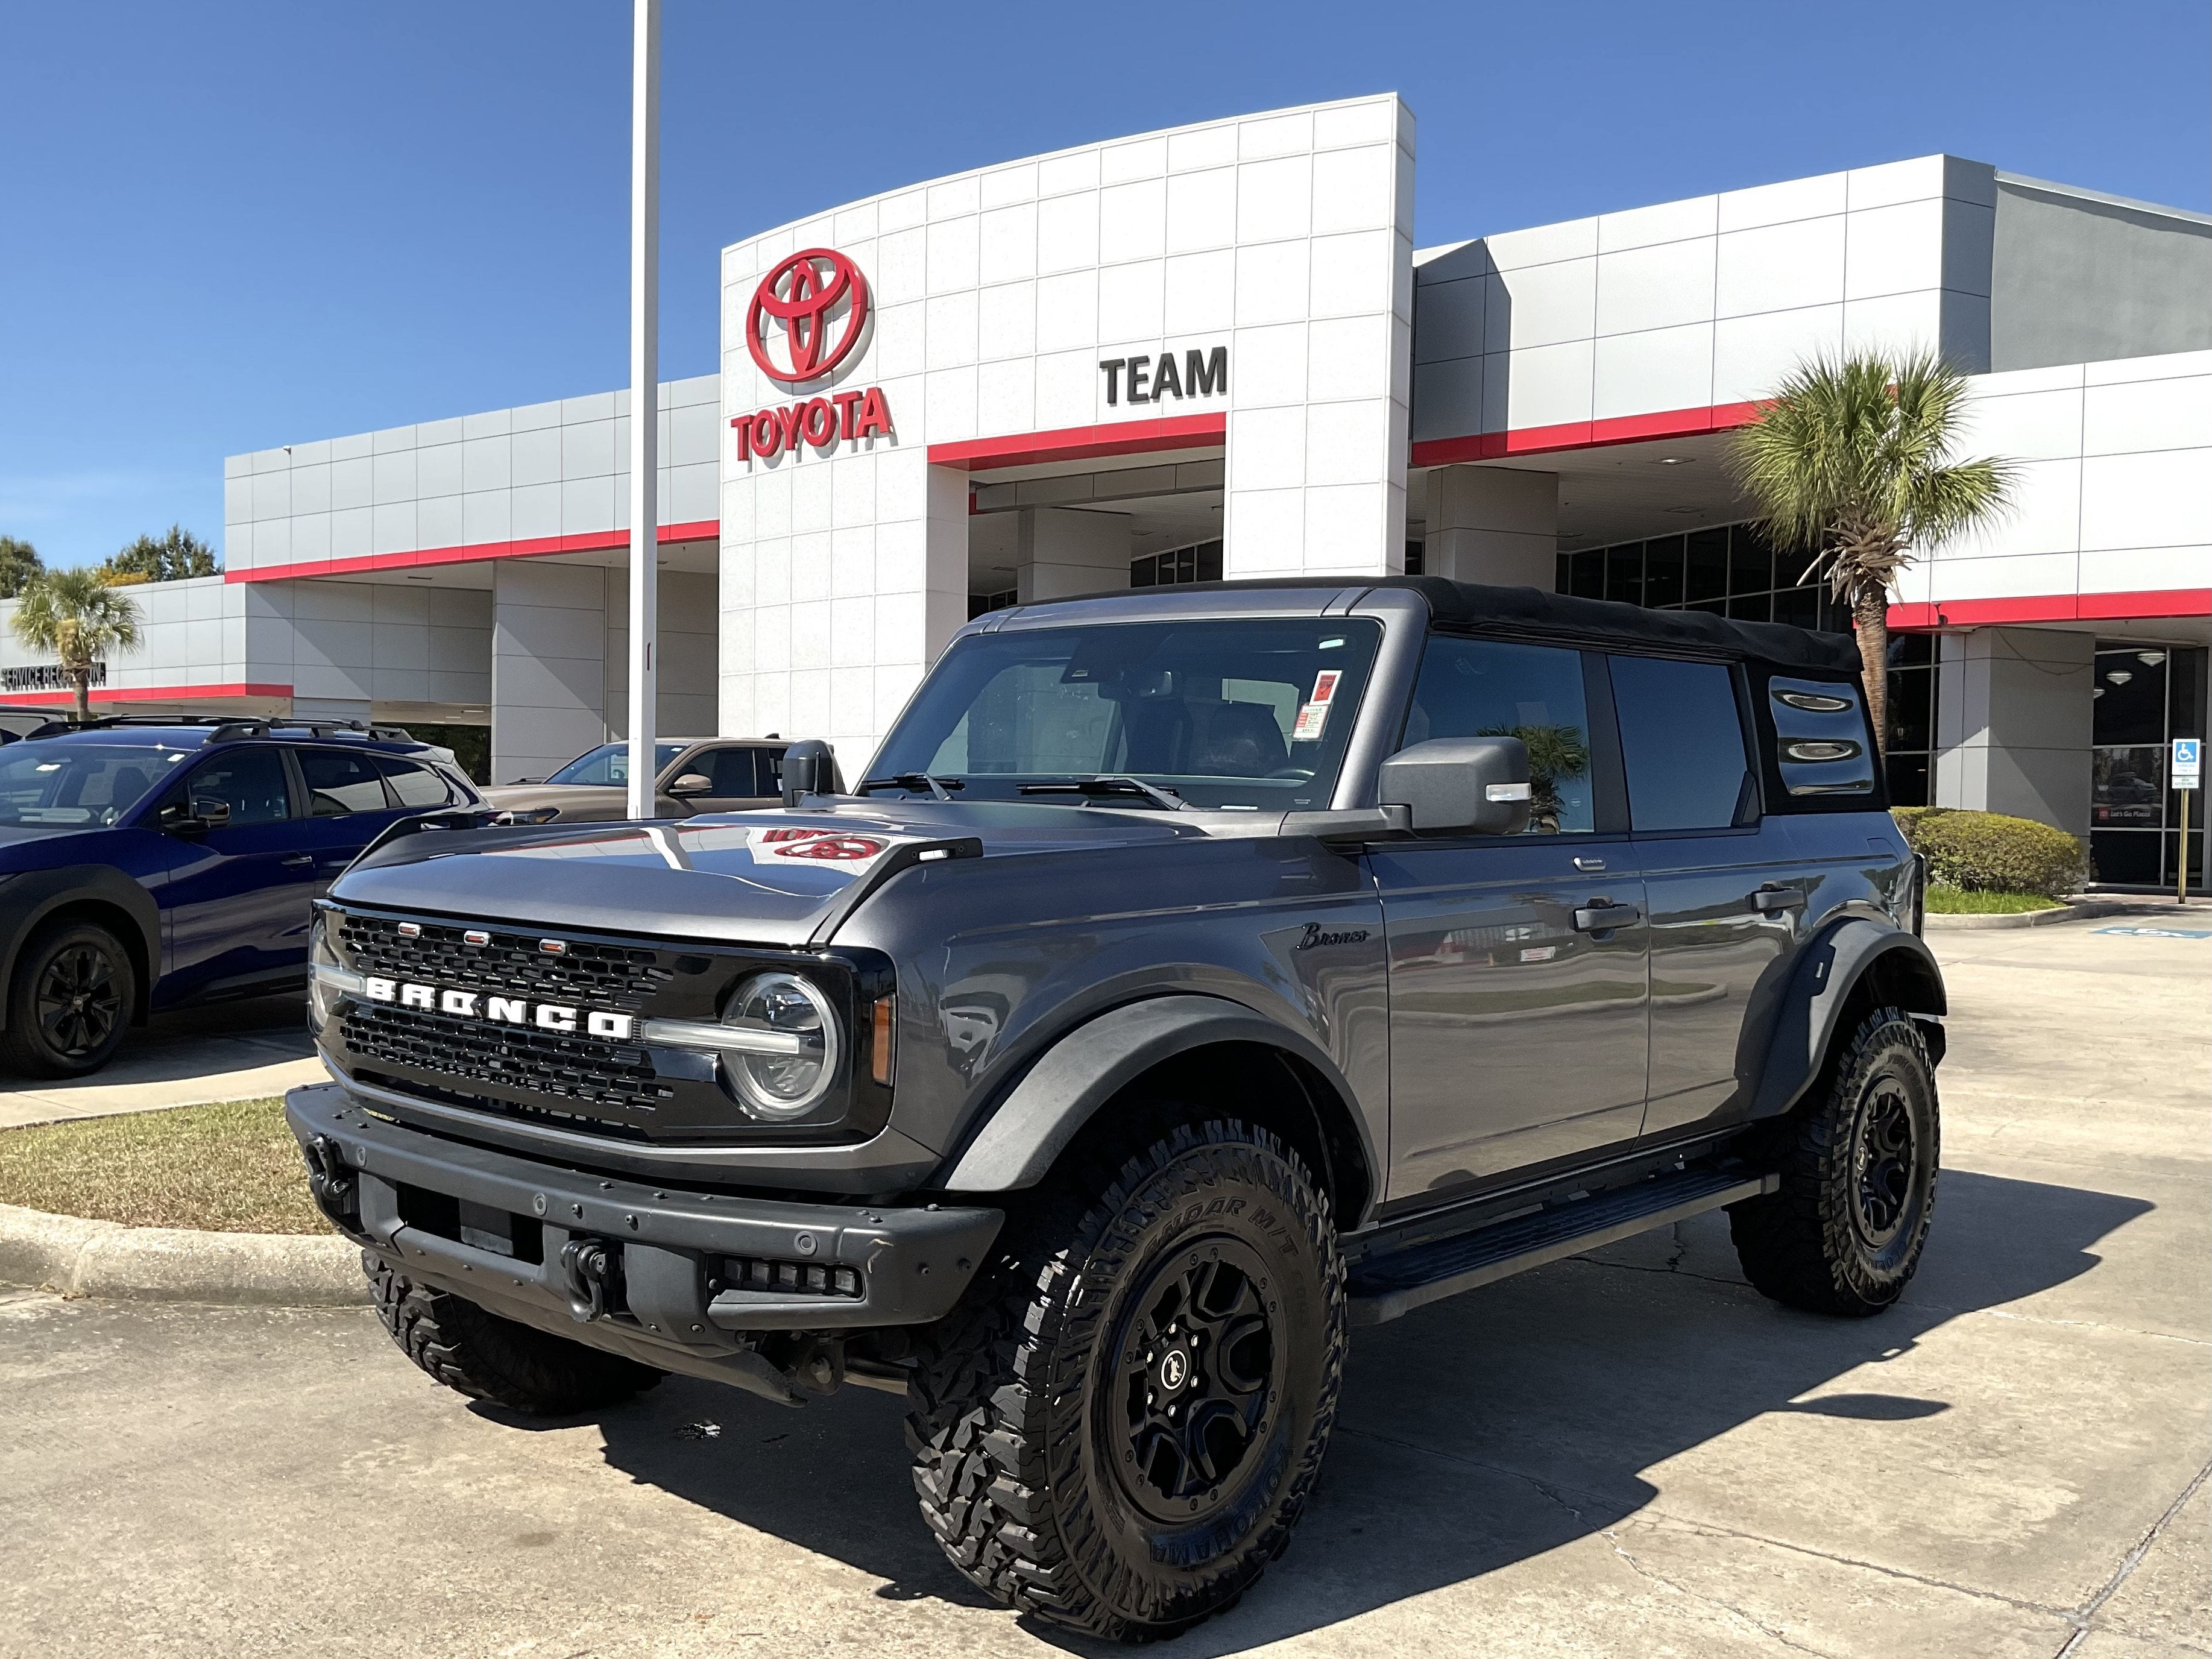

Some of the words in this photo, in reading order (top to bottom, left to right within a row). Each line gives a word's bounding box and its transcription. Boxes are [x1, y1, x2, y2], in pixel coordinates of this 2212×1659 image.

[1100, 346, 1227, 405] TEAM
[730, 386, 894, 462] TOYOTA
[1, 666, 42, 688] SERVICE
[1296, 921, 1371, 951] Bronco
[365, 976, 632, 1039] BRONCO
[1248, 1204, 1299, 1257] M/T
